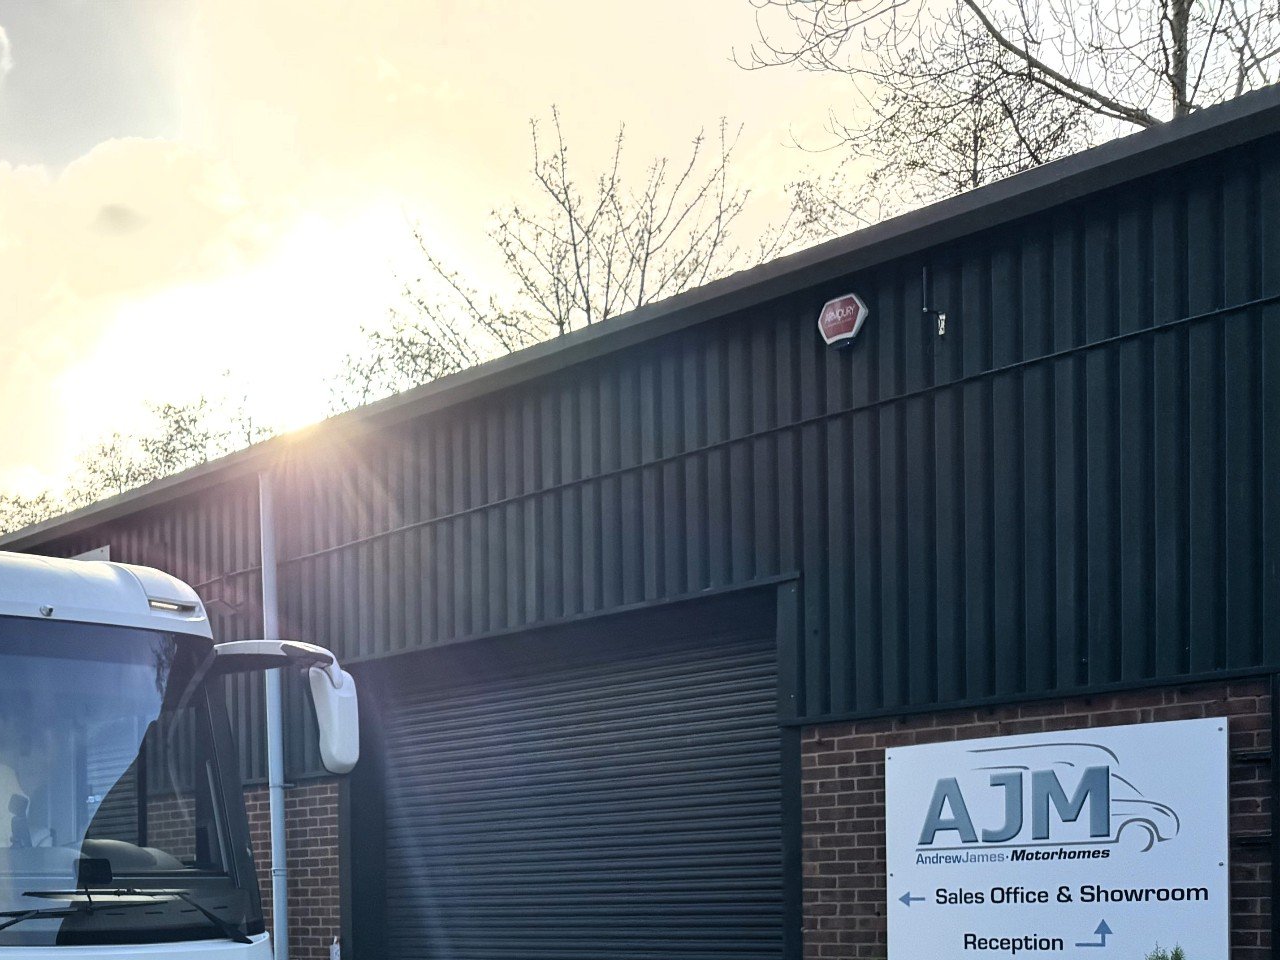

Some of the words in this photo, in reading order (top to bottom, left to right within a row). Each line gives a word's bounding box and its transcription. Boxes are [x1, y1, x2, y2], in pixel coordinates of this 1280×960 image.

[918, 765, 1111, 845] AJM
[1010, 847, 1111, 862] Motorhomes
[935, 888, 985, 905] Sales
[990, 886, 1049, 904] Office
[1056, 885, 1074, 903] &
[1080, 884, 1209, 902] Showroom
[963, 933, 1064, 955] Reception
